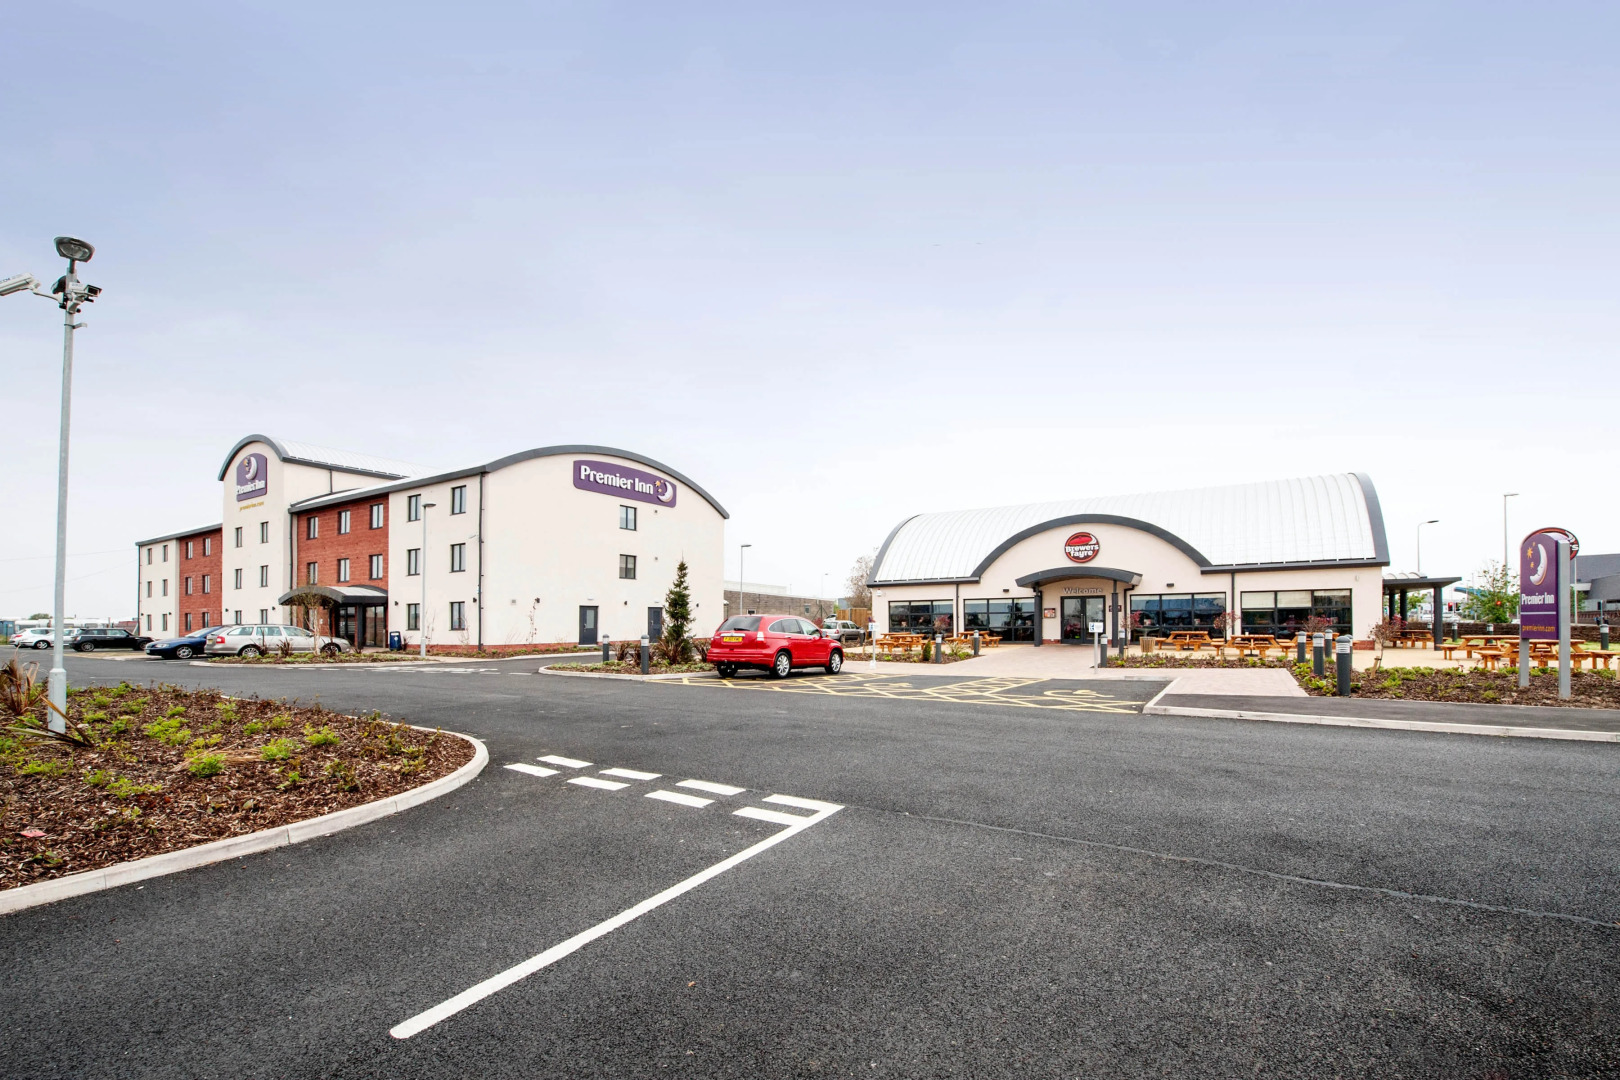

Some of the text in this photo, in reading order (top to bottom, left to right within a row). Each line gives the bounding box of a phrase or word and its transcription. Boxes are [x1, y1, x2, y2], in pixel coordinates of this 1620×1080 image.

[580, 465, 653, 494] Premier Inn
[237, 482, 256, 495] Premier
[1065, 544, 1099, 553] Brewers
[1063, 587, 1103, 595] Welcome
[1521, 592, 1554, 605] Premier Inn
[1522, 624, 1555, 632] premierinn.com
